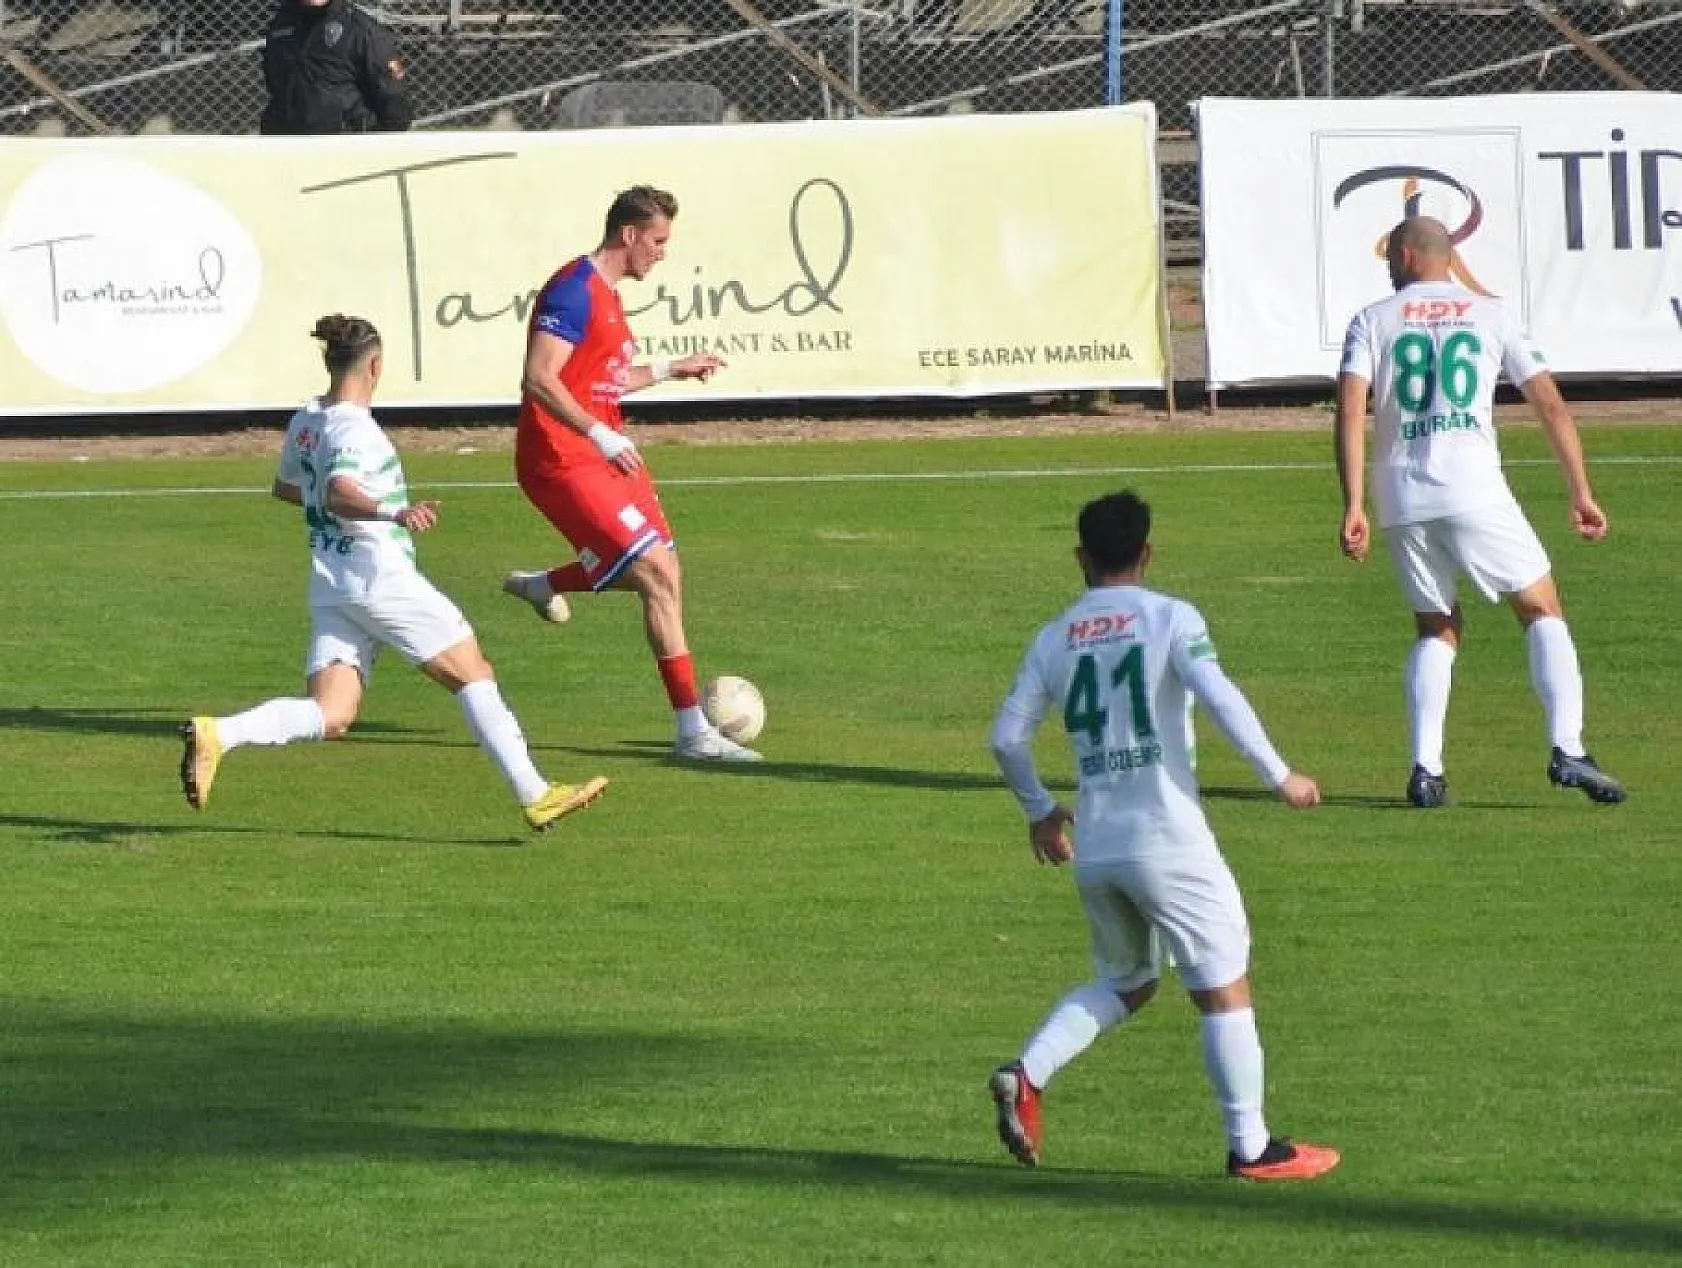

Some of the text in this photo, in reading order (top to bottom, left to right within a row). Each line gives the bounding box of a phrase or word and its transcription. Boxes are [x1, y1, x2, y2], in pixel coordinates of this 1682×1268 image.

[10, 233, 225, 325] Tamarind
[302, 151, 853, 382] Tarind
[632, 329, 852, 356] STAURANT & BAR
[918, 339, 1133, 368] ECE SARAY MARİNA
[1393, 330, 1482, 413] 86
[1065, 644, 1154, 746] 41
